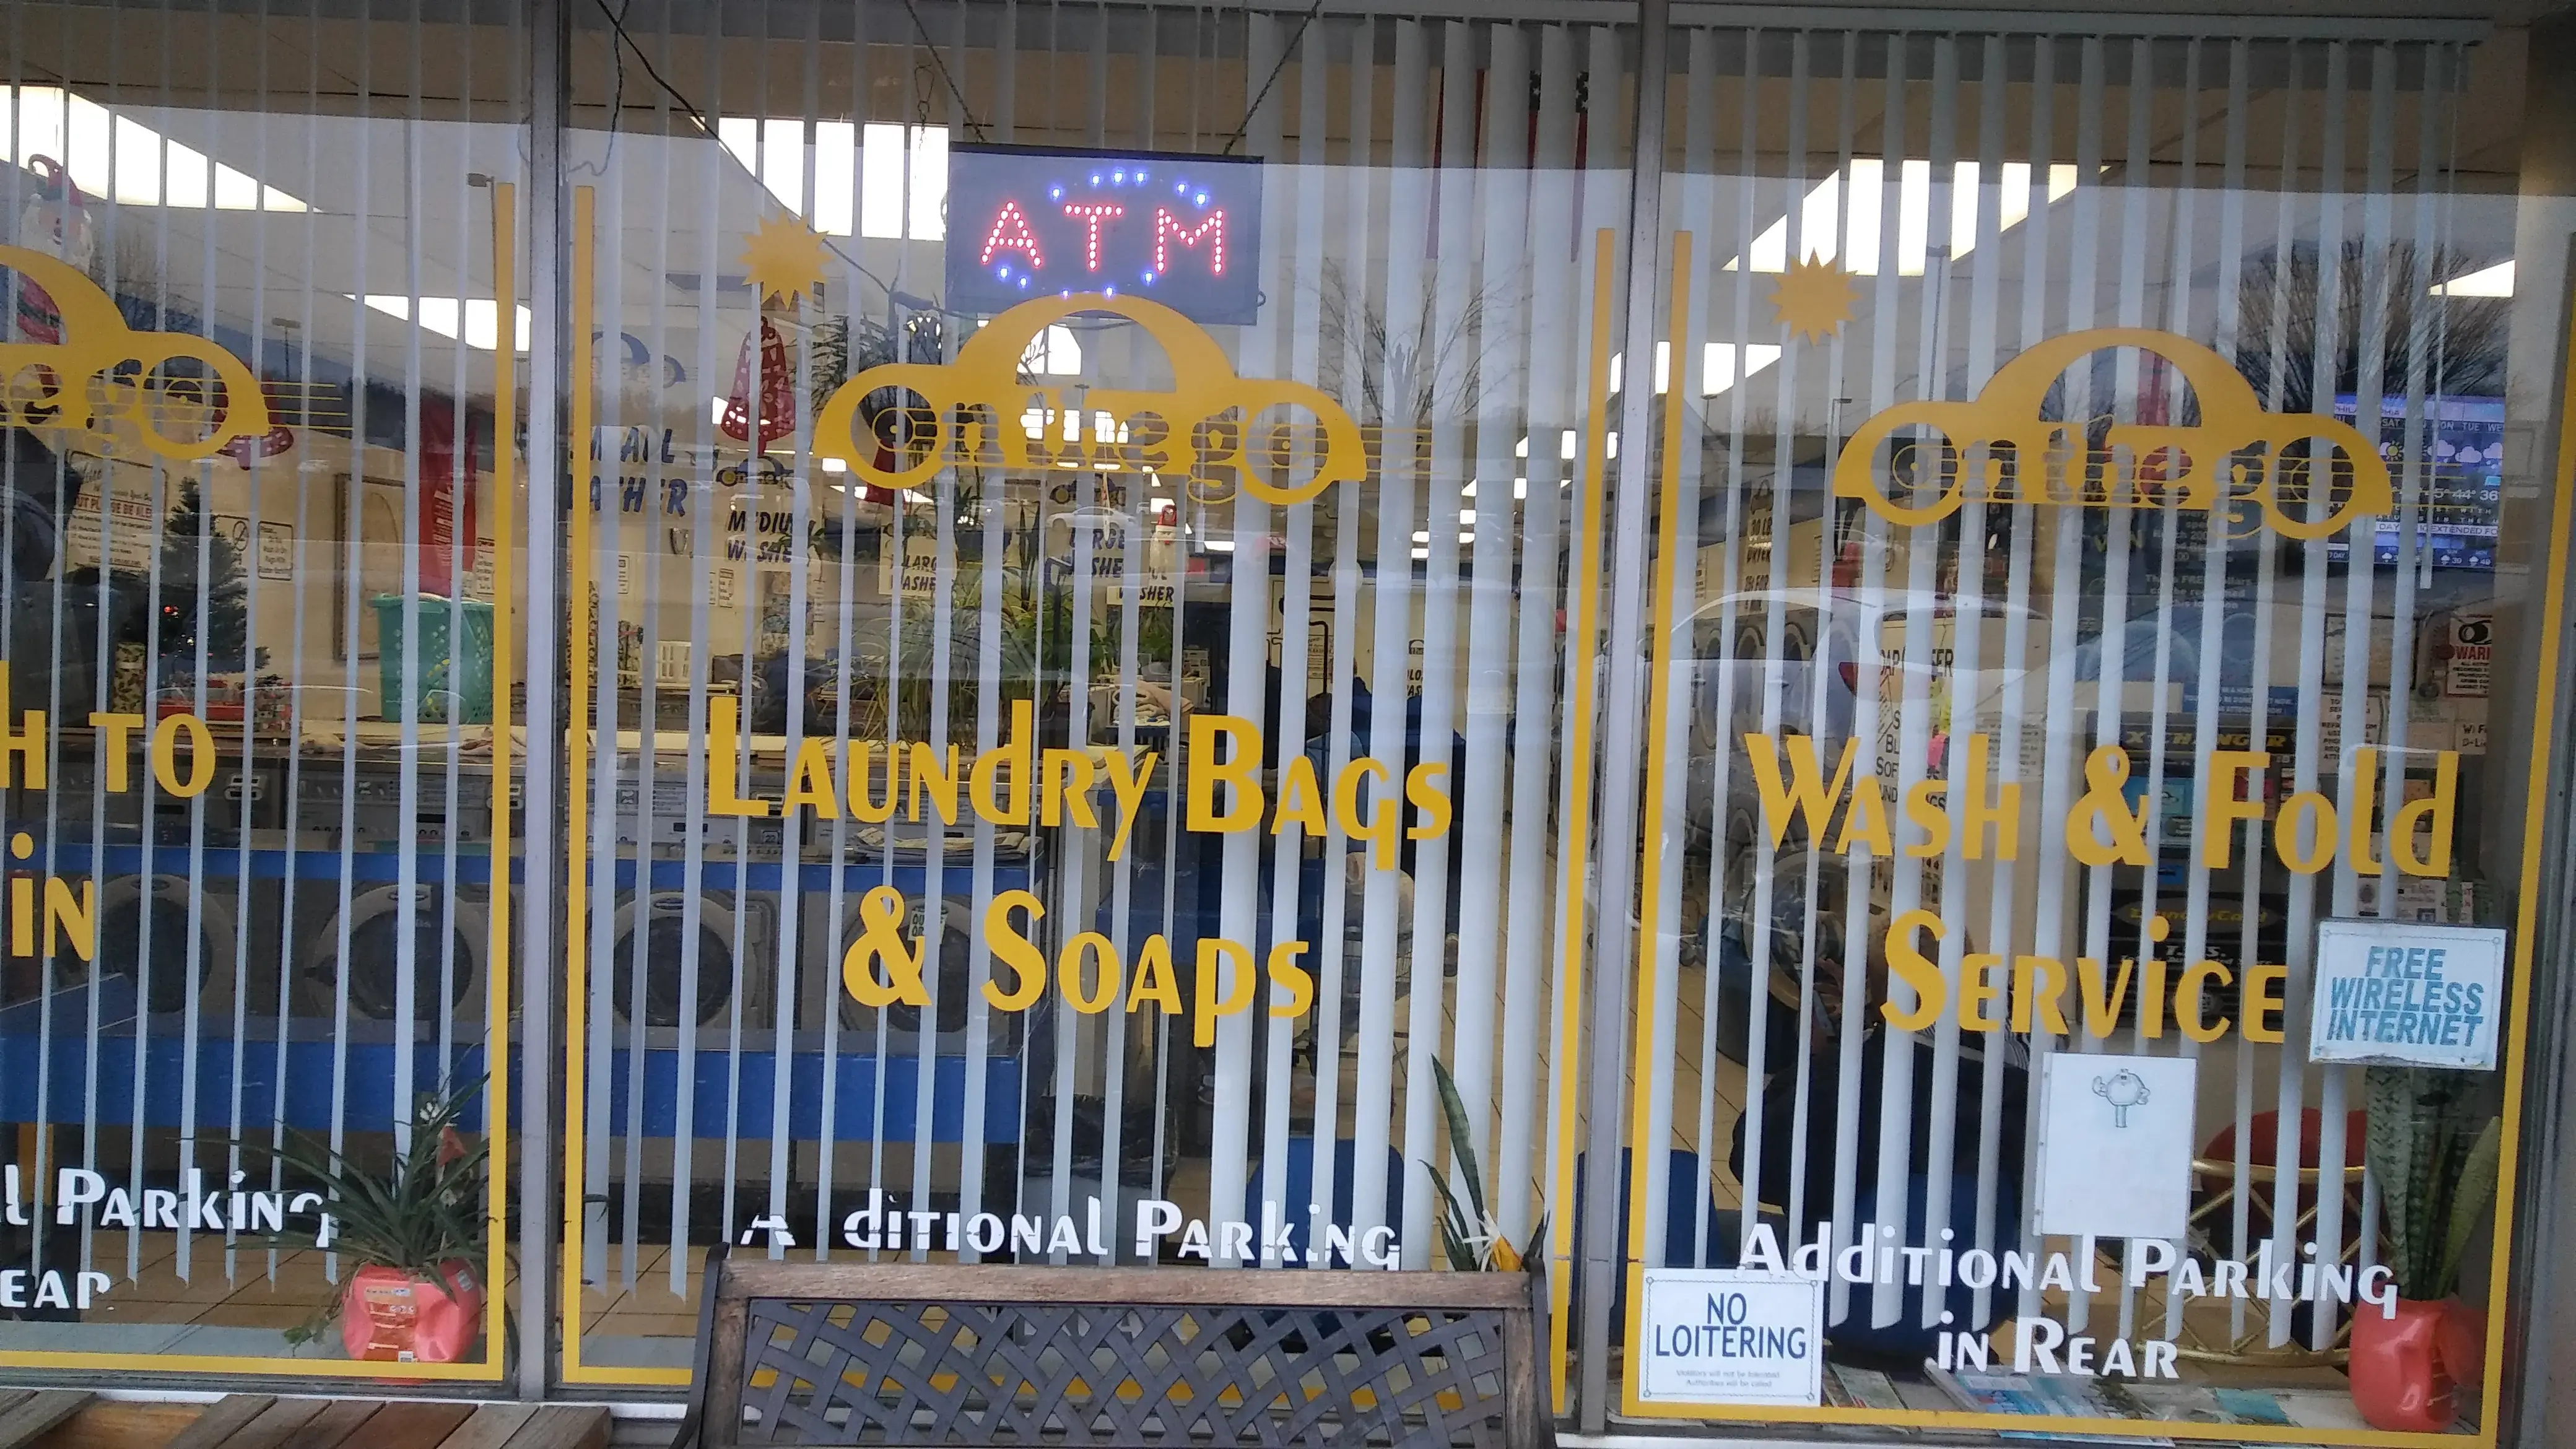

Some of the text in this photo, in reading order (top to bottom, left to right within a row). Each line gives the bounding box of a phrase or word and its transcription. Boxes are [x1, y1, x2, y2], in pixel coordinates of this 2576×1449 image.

[980, 200, 1225, 275] ATM
[2068, 749, 2149, 865] &
[844, 886, 929, 1007] &
[2365, 945, 2447, 980] FREE
[2330, 977, 2484, 1015] WIRELESS
[2326, 1008, 2484, 1046] INTERNET
[1707, 1292, 1746, 1325] NO
[1655, 1324, 1806, 1359] LOITERING
